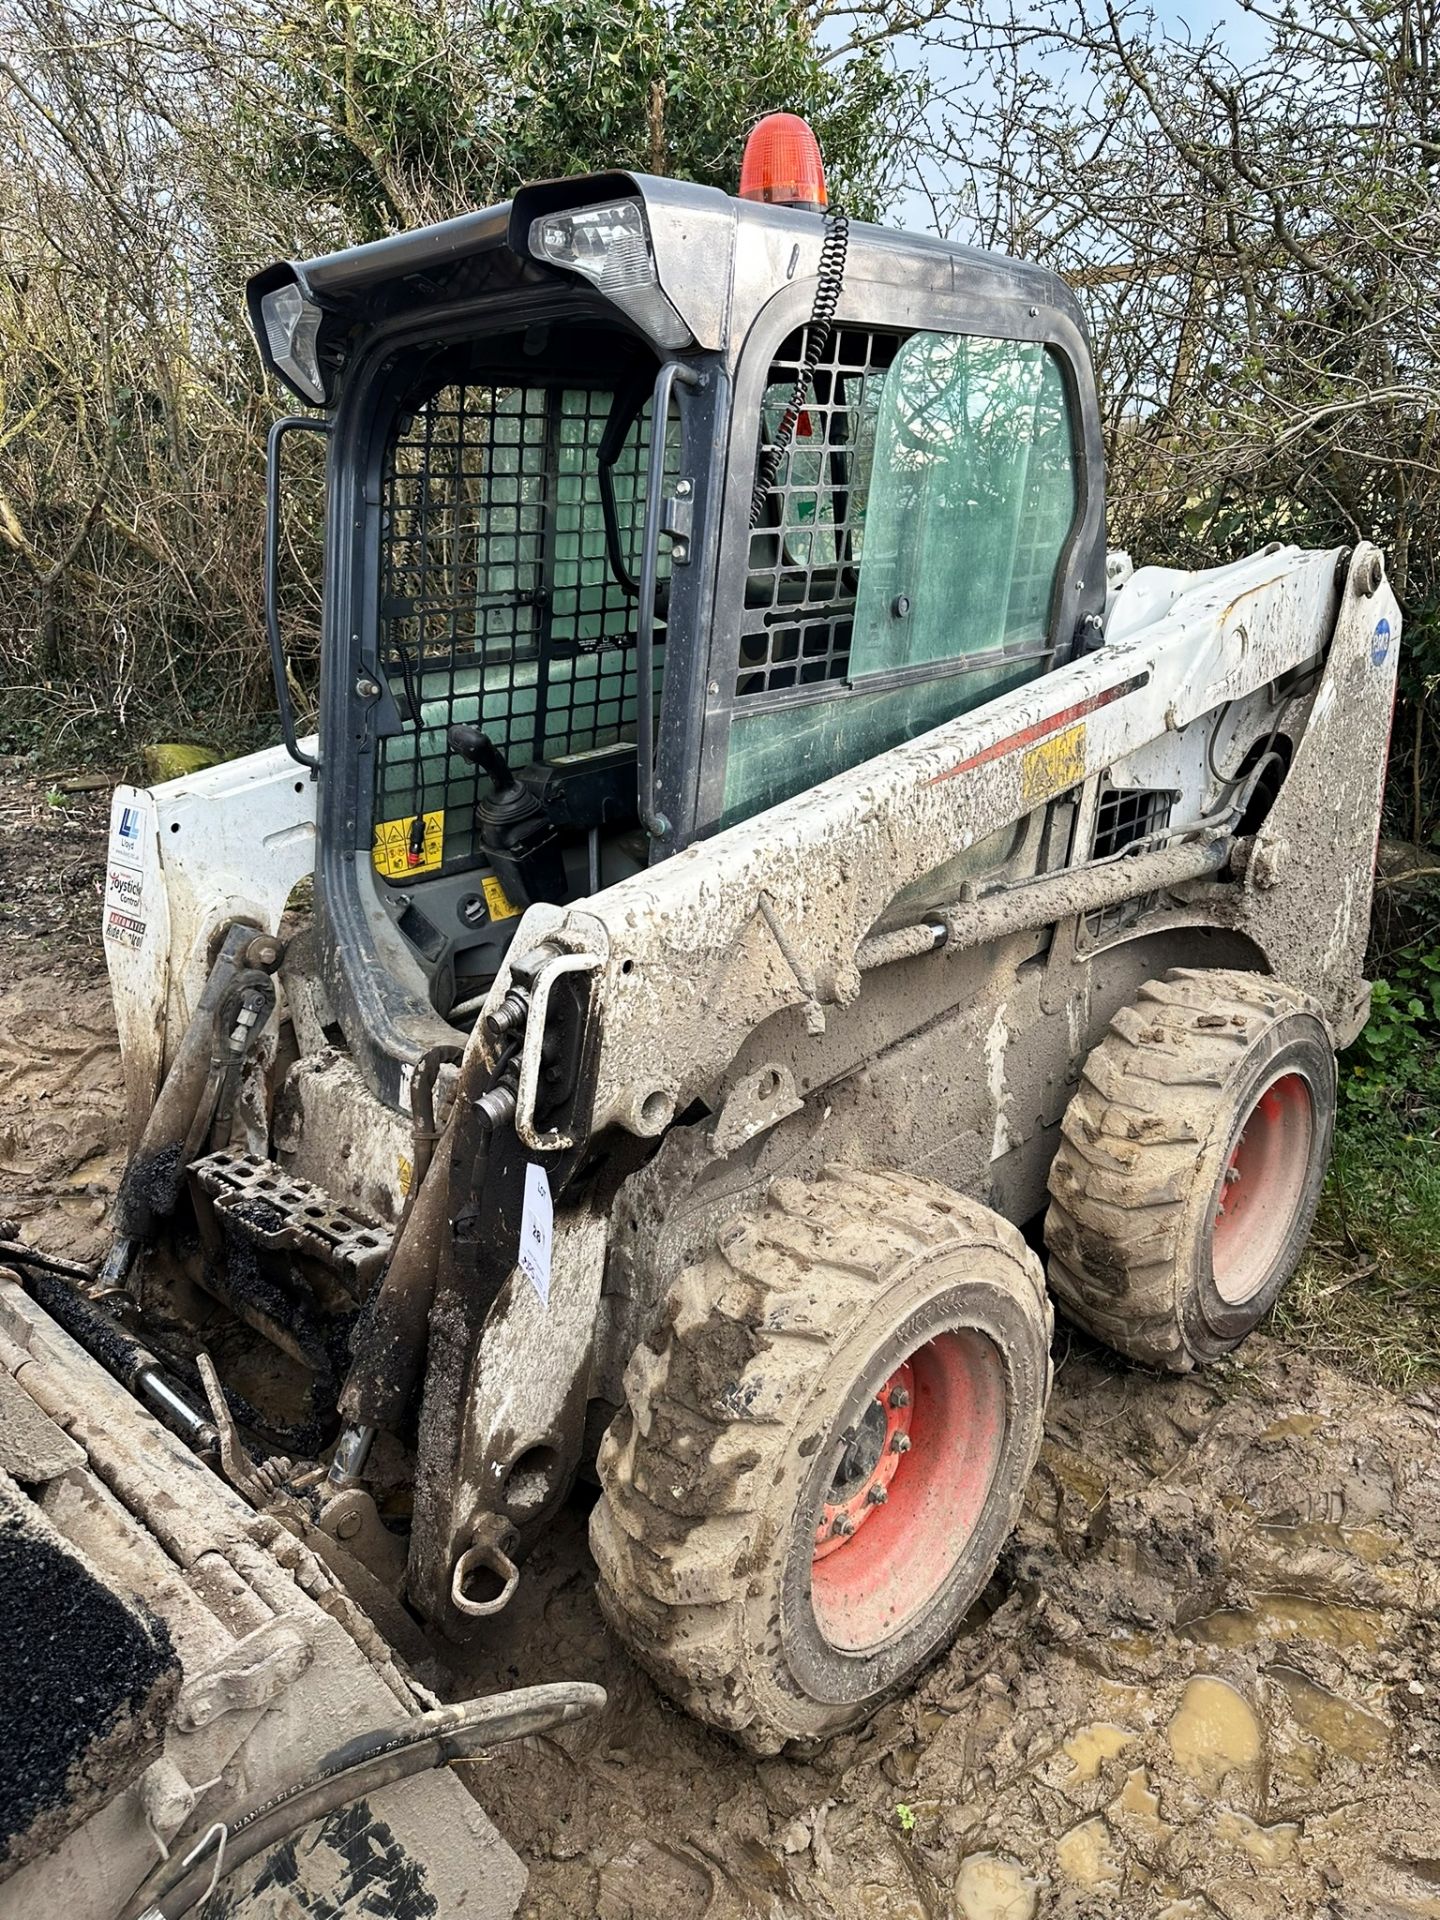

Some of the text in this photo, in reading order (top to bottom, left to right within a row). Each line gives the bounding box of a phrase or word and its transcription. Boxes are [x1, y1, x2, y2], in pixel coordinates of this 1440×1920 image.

[121, 838, 134, 850] Lloyd
[110, 874, 143, 896] Joystick
[120, 893, 140, 907] Control
[110, 913, 145, 934] AUTOMATIC
[106, 923, 144, 948] Ride Cntrol
[234, 1784, 305, 1832] HANSA-FLEX
